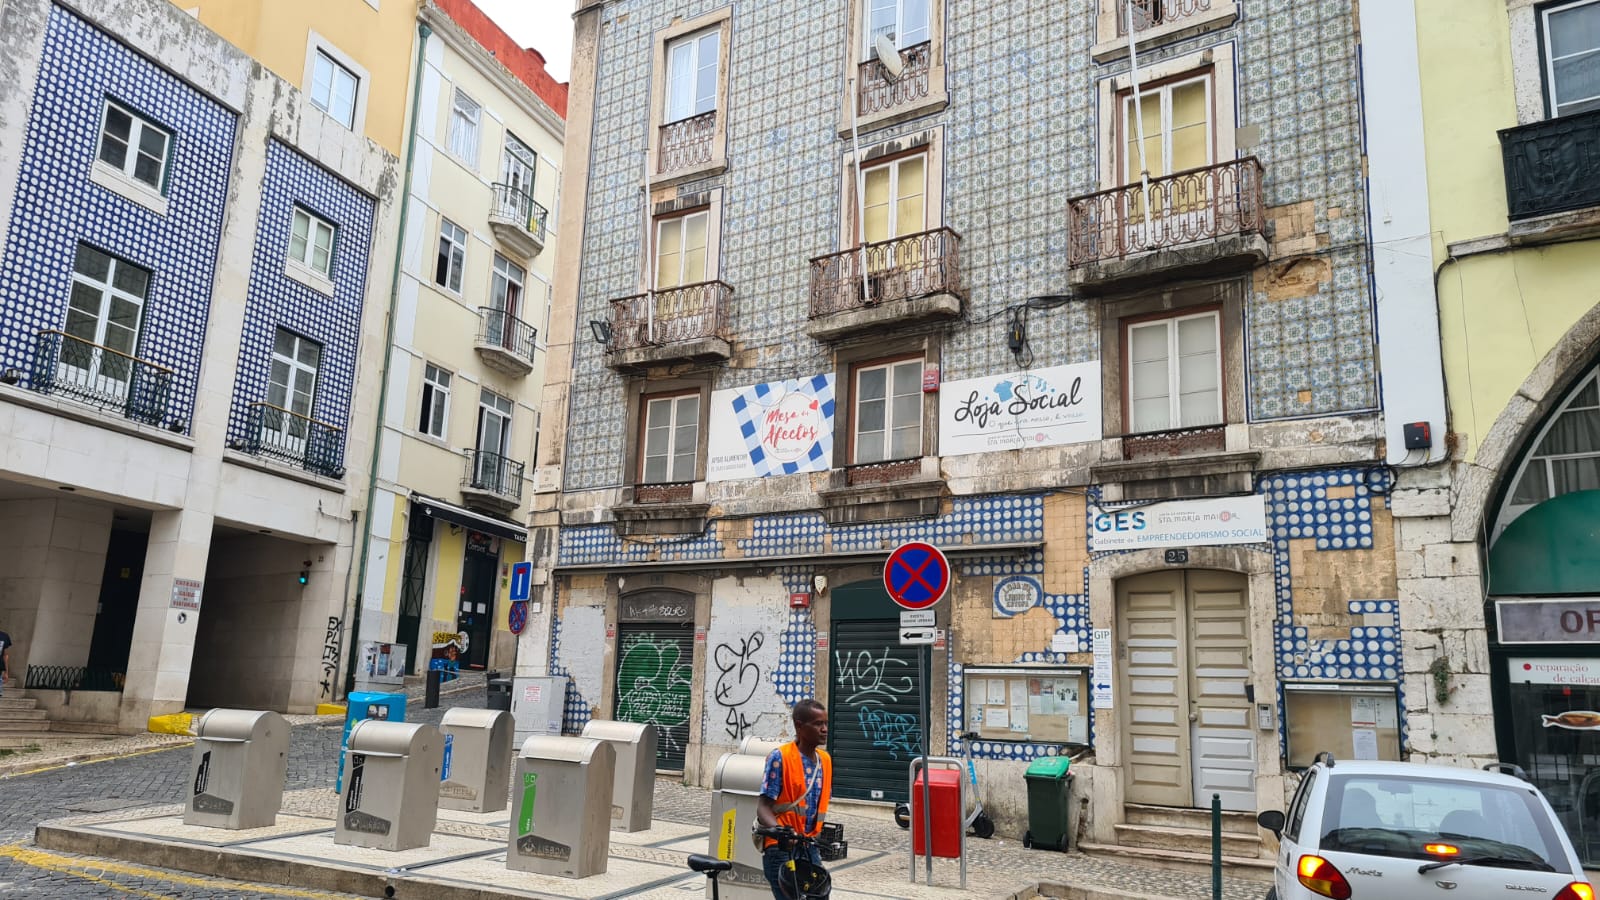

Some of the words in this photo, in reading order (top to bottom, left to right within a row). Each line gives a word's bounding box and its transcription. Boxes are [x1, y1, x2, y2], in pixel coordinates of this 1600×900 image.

[954, 390, 1002, 429] Loja
[1008, 376, 1083, 415] Social
[765, 408, 798, 425] Mesa
[763, 423, 819, 448] Afectos
[1094, 511, 1147, 533] GES
[1137, 530, 1230, 543] EMPREENDEDORISMO
[1231, 528, 1265, 538] SOCIAL
[1167, 552, 1186, 562] 25
[1094, 630, 1110, 640] GIP
[1535, 663, 1589, 674] reparação
[1553, 673, 1566, 683] de
